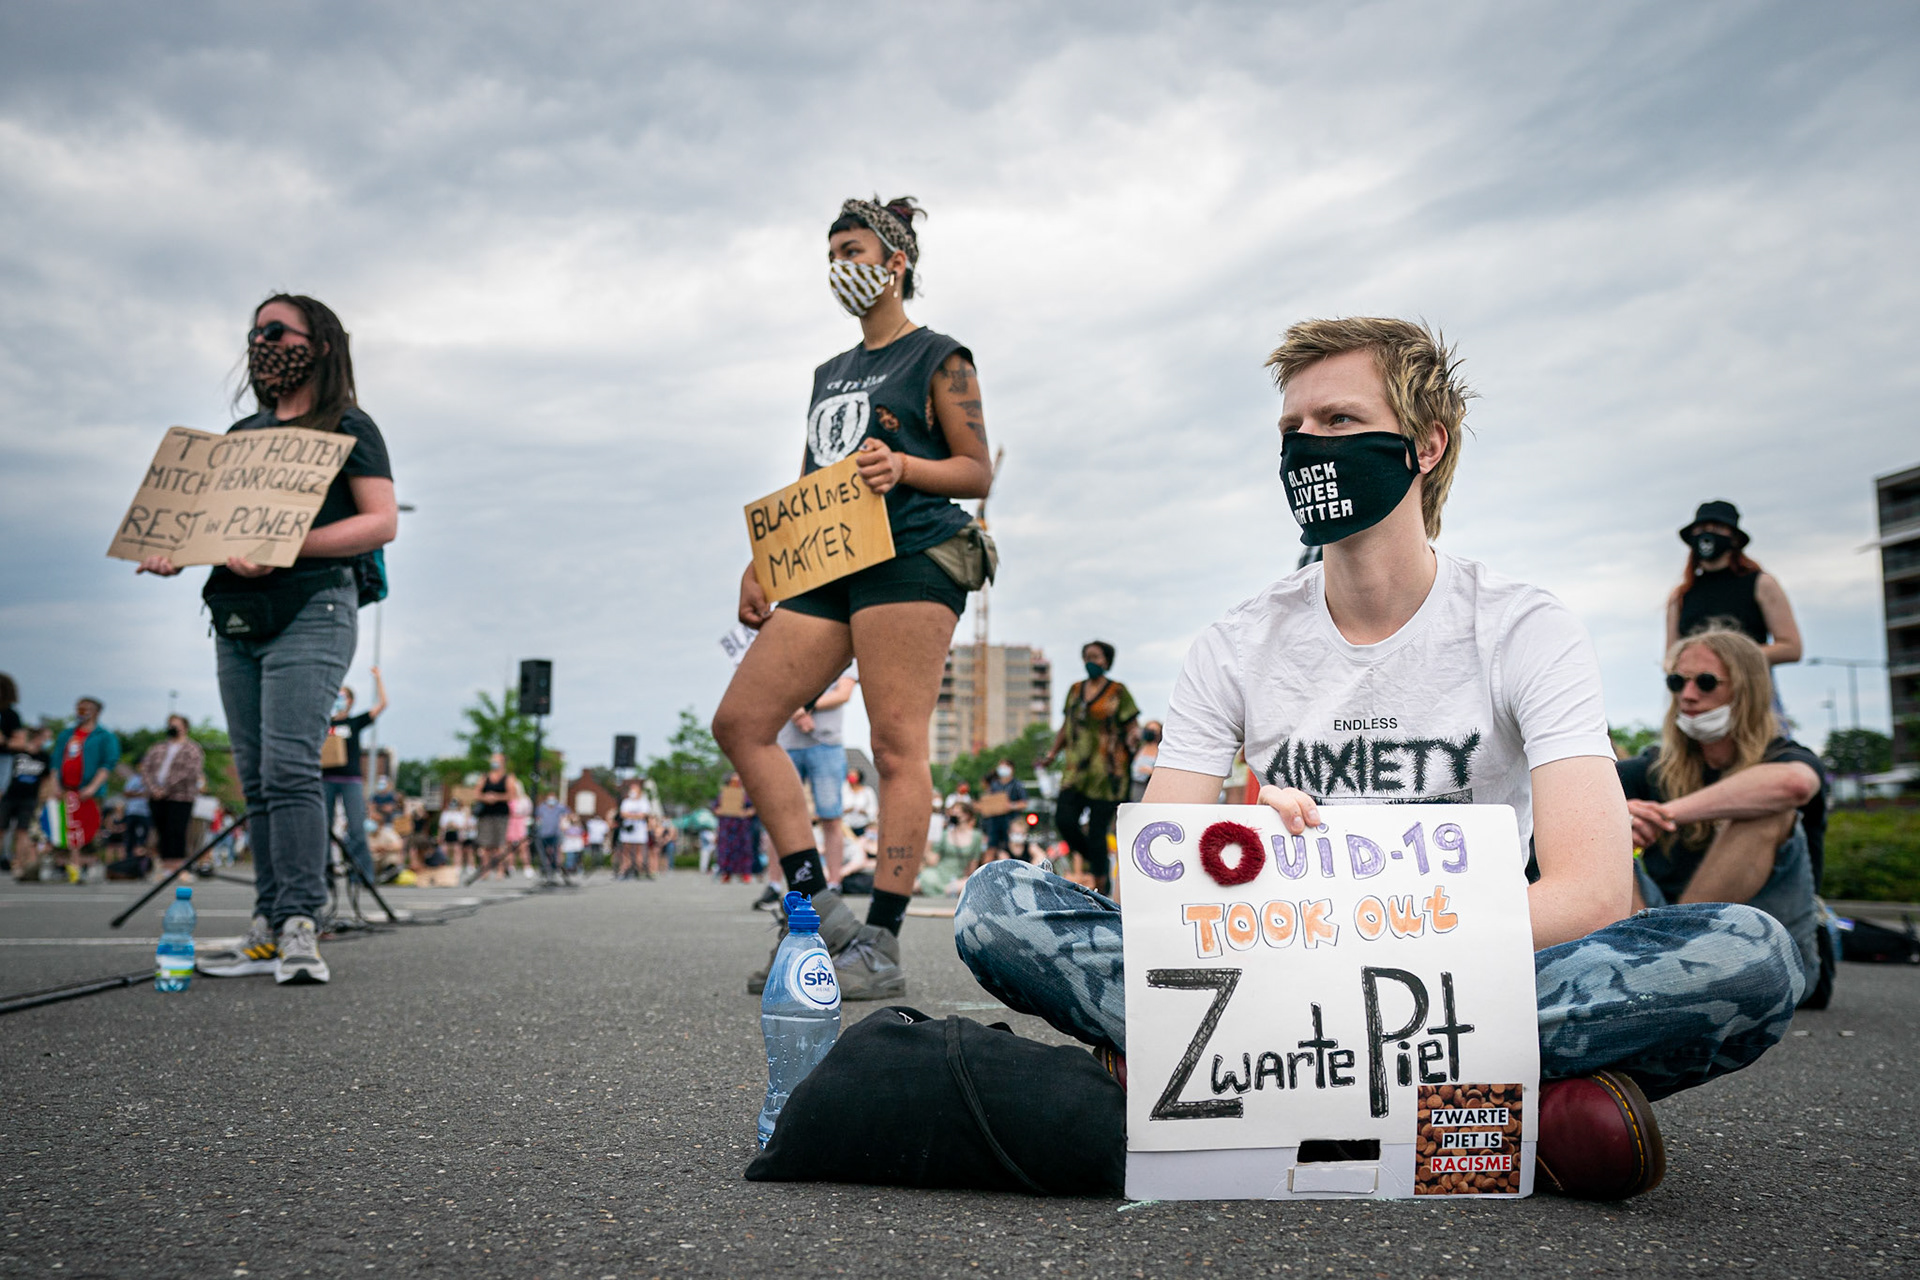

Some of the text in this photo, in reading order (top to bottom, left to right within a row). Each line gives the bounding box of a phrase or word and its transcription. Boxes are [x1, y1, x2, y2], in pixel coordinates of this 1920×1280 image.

[263, 434, 351, 468] HOLTEN
[143, 465, 328, 496] MITCH HENRIQUEZ
[1287, 461, 1338, 488] BLACK
[1293, 481, 1339, 507] LIVES
[121, 505, 206, 545] REST
[223, 506, 311, 539] POWER
[751, 488, 813, 542] BLACK
[768, 522, 856, 588] MATTER
[1333, 717, 1398, 731] ENDLESS
[1263, 727, 1481, 795] ANXIETY
[1181, 898, 1340, 959] TOOK
[804, 972, 836, 986] SPA
[1361, 965, 1475, 1118] Piet
[1432, 1109, 1507, 1125] ZWARTE
[1443, 1132, 1500, 1148] PIET IS
[1432, 1156, 1511, 1172] RACISME
